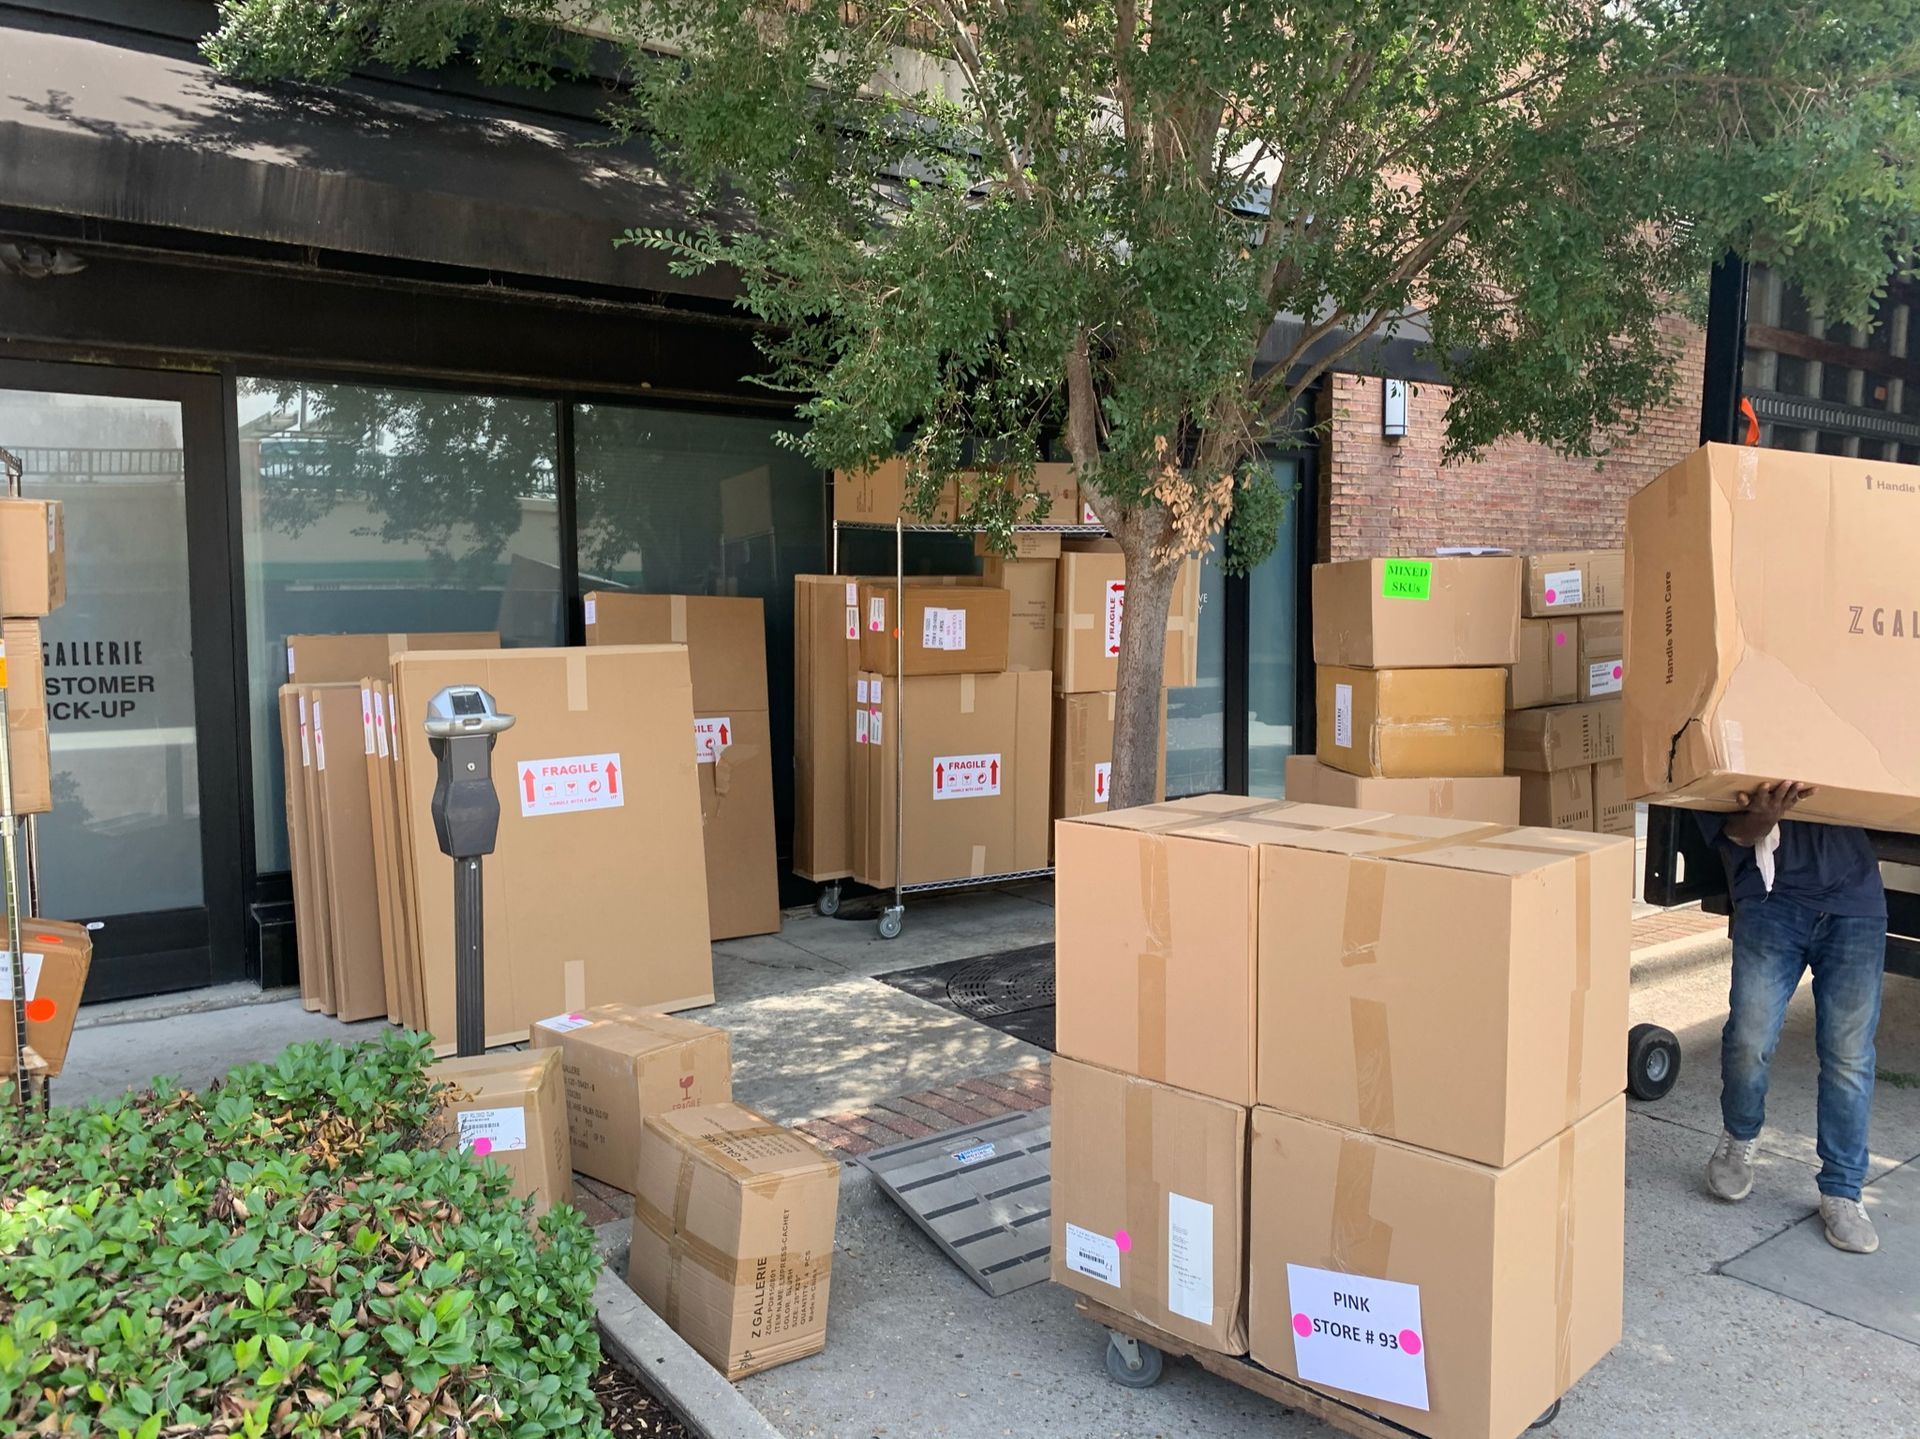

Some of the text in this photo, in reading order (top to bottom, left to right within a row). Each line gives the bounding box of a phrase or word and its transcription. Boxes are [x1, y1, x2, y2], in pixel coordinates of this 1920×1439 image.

[1877, 480, 1915, 493] Handle
[1388, 565, 1428, 577] MIXED
[1391, 581, 1421, 593] SKUs
[1664, 571, 1674, 685] Handle With Care
[541, 762, 600, 777] FRAGILE
[948, 760, 987, 770] FRAGILE
[752, 1256, 768, 1339] Z GALLERIE
[1333, 1291, 1371, 1313] PINK
[1313, 1318, 1399, 1350] STORE # 93
